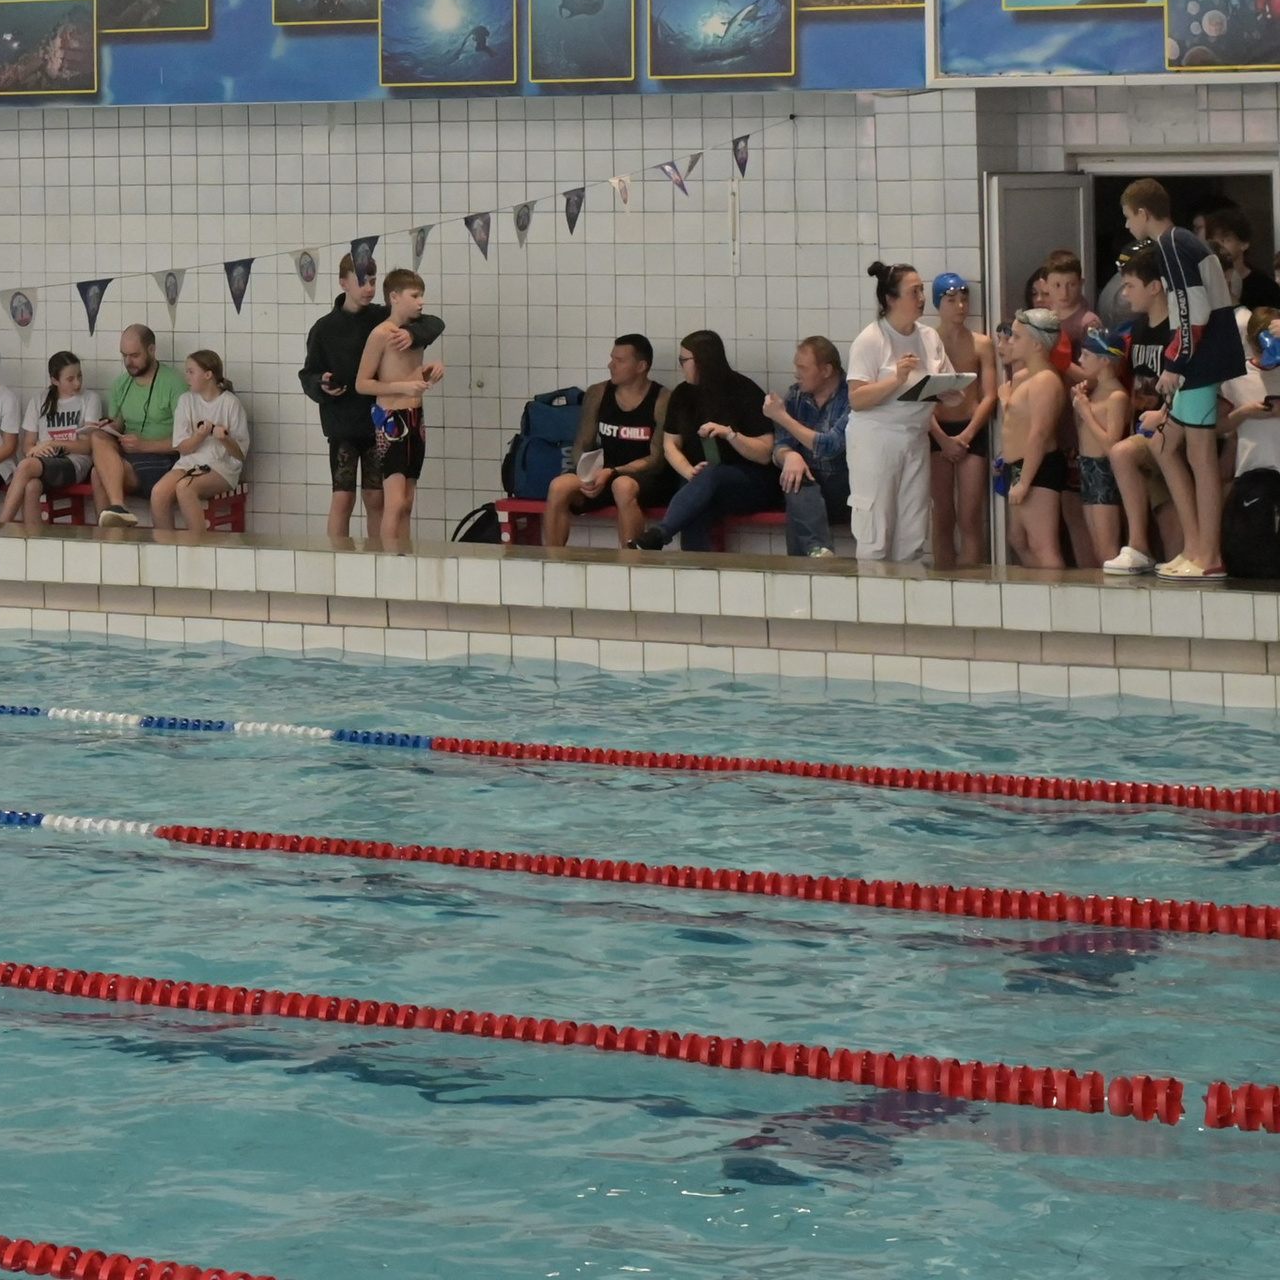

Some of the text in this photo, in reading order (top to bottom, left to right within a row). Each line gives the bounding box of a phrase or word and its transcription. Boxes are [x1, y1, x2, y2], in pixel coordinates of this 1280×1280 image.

[1177, 289, 1188, 315] CREW
[1181, 317, 1190, 348] YACHT
[620, 427, 650, 439] CHILL.
